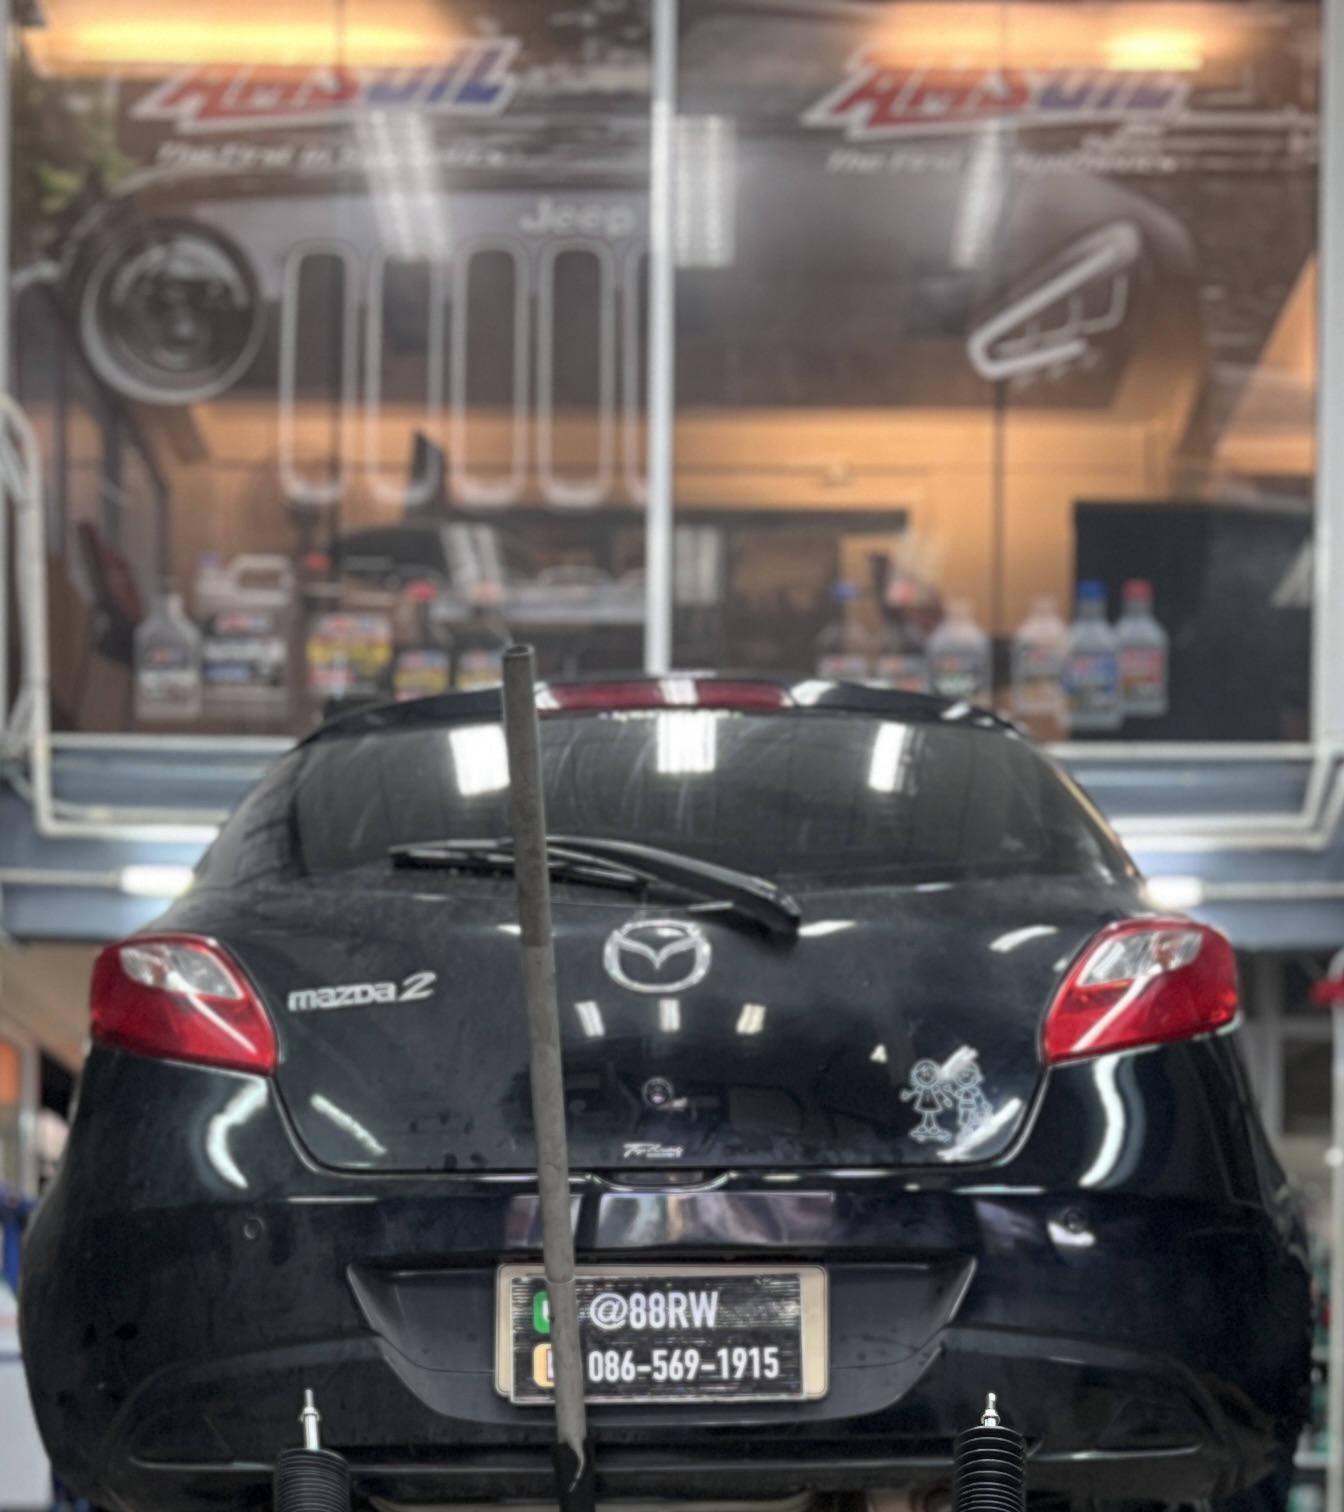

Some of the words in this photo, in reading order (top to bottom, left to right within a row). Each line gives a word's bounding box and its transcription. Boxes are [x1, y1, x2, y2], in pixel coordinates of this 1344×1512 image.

[518, 196, 635, 238] Jeep
[398, 970, 437, 1002] 2
[590, 1291, 719, 1330] @88RW
[588, 1347, 780, 1383] 086-569-1915
